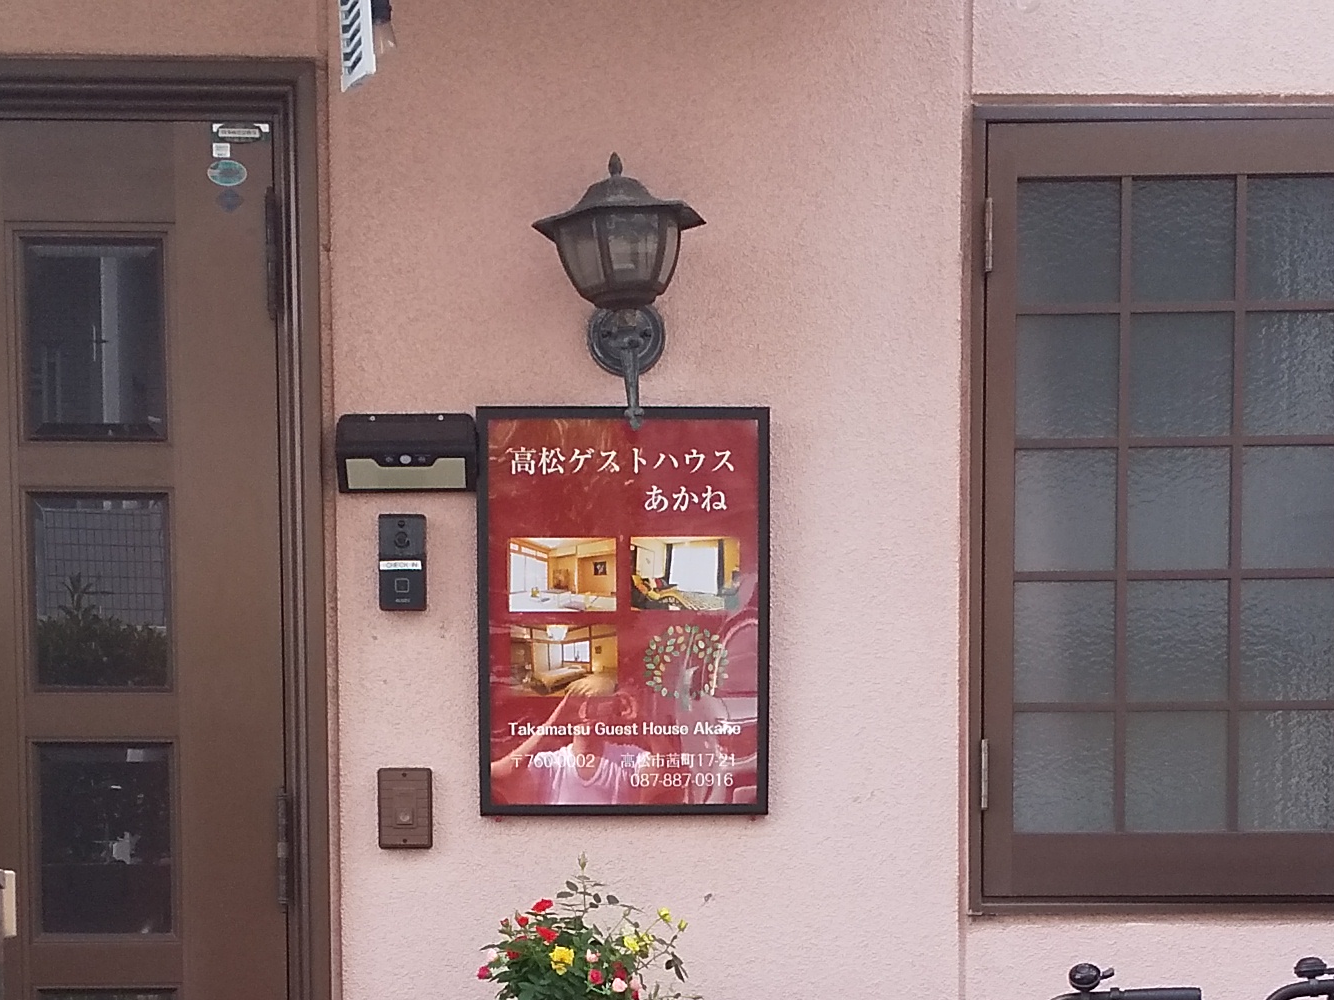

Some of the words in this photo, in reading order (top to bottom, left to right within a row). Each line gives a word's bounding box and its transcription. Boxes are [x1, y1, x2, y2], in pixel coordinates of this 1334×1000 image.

[509, 446, 736, 476] 高松ゲストハウス
[644, 484, 729, 512] あかね
[508, 721, 590, 736] Takamatsu
[594, 722, 639, 736] Guest
[642, 721, 689, 736] House
[693, 721, 742, 736] Akane
[630, 773, 734, 788] 087-887-0916
